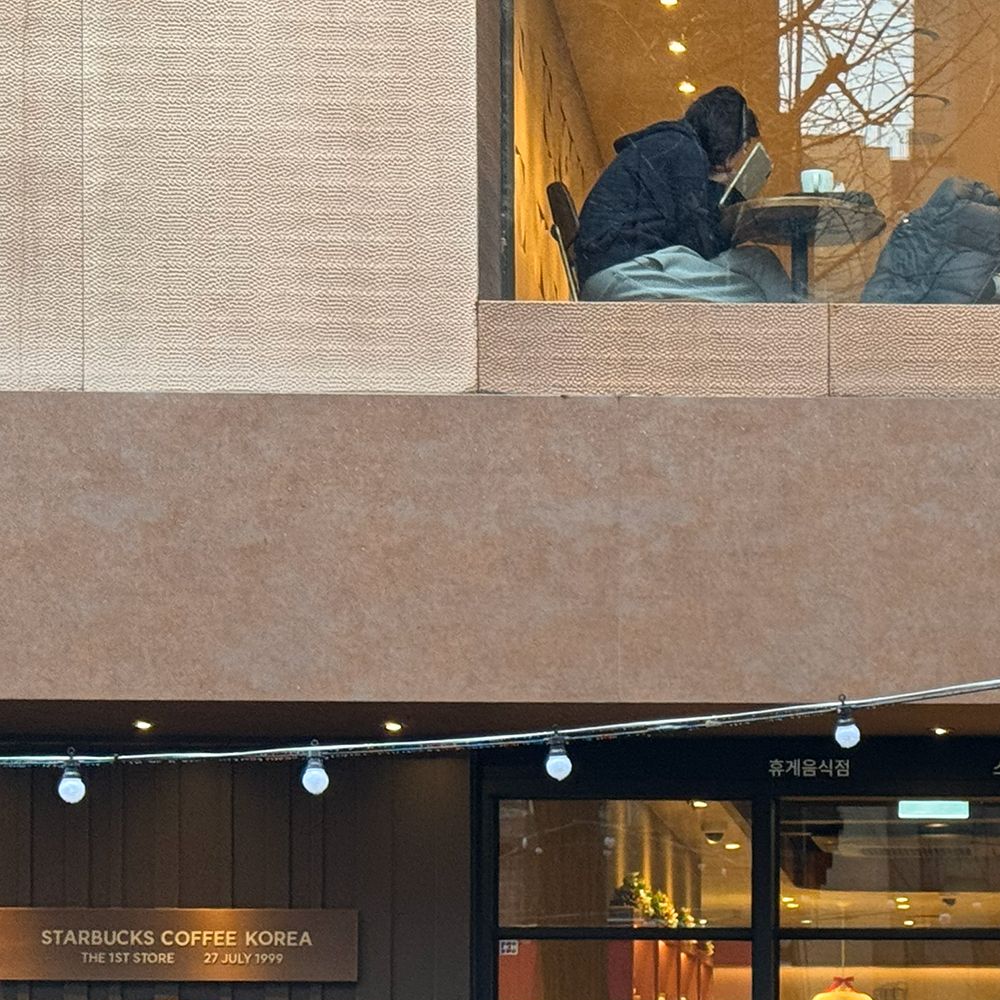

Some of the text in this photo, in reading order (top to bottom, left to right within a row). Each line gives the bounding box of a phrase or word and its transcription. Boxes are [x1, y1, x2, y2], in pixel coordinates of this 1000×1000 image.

[768, 758, 850, 777] 휴게음식점
[41, 929, 312, 947] STARBUCKS COFFEE KOREA
[81, 952, 283, 965] THE 1ST STORE 27 JULY 1999
